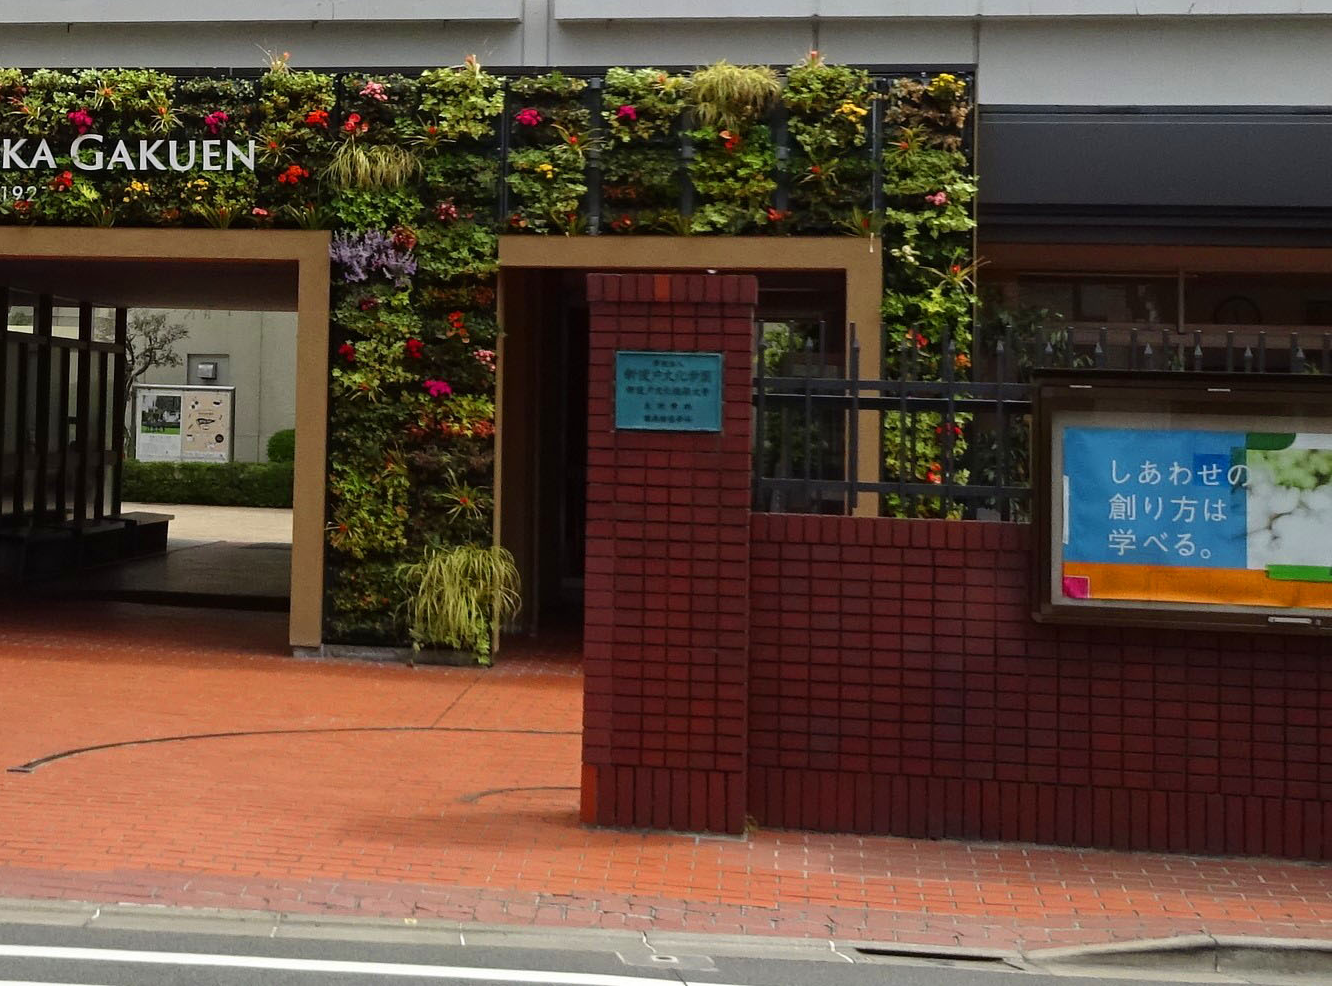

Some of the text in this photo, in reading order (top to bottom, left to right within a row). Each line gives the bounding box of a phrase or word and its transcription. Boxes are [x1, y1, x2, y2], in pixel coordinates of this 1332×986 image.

[71, 133, 256, 172] GAKUEN
[1, 185, 47, 202] 192
[1111, 459, 1250, 487] しあわせの
[1108, 494, 1227, 523] 創り方は
[1108, 528, 1212, 560] 学べる。
